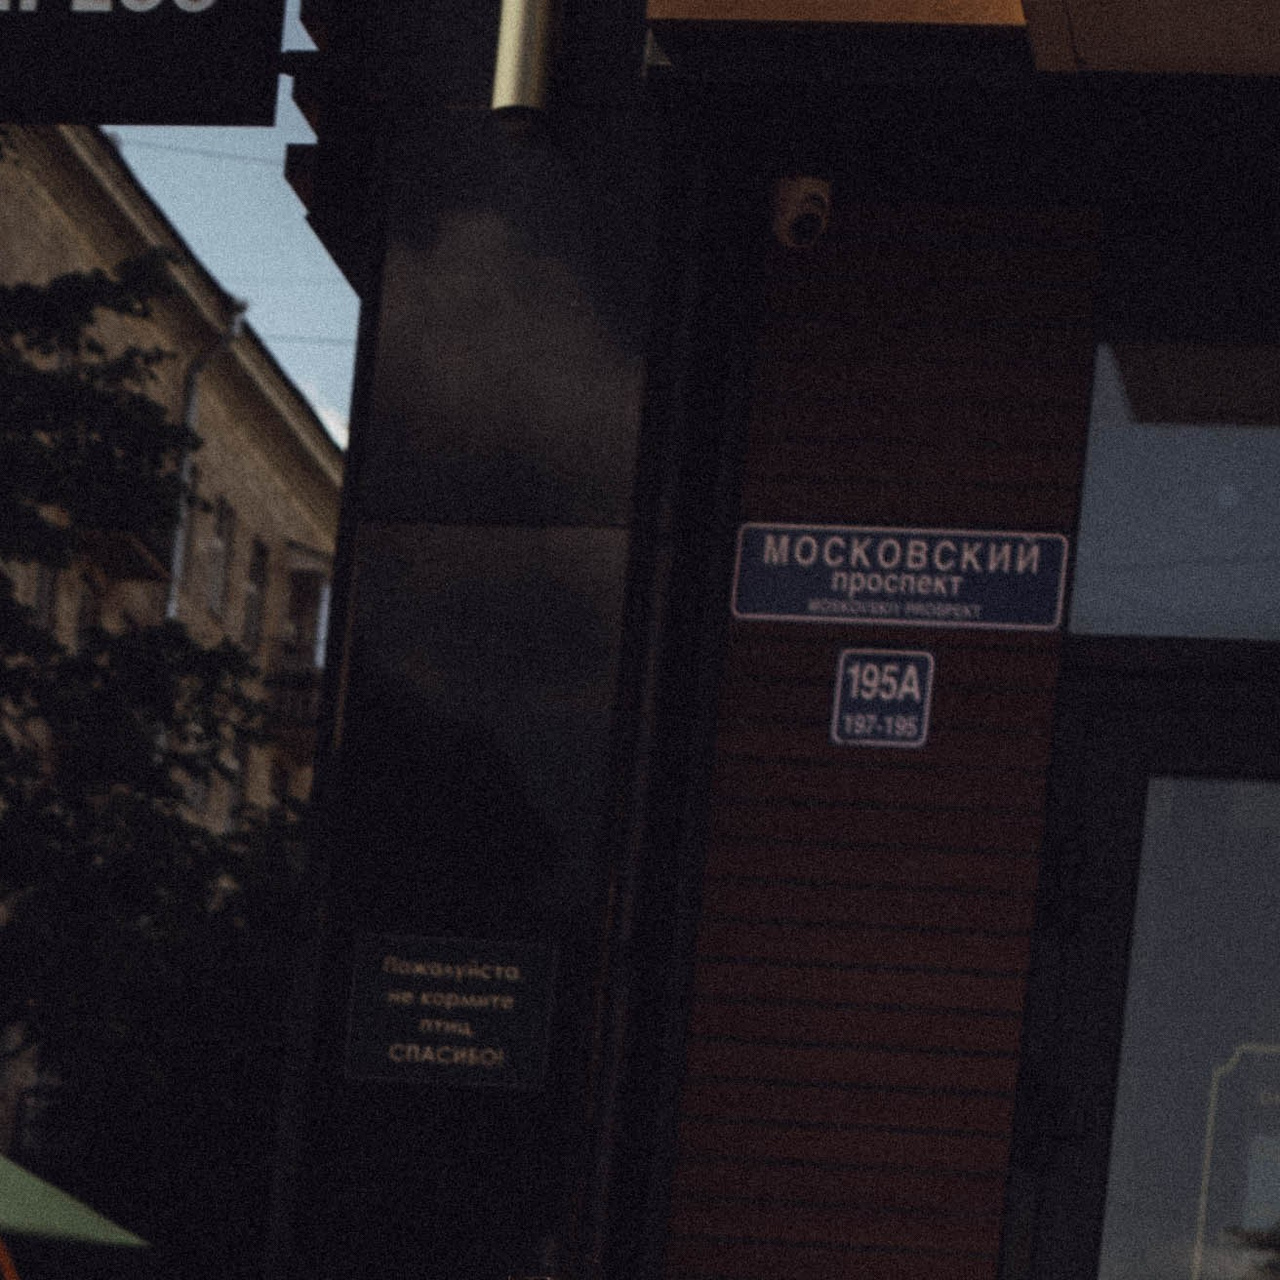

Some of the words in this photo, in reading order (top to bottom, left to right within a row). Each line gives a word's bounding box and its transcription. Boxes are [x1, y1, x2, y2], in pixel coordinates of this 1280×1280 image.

[763, 534, 1040, 574] МОСКОВСКИЙ
[830, 570, 963, 597] проспект
[846, 662, 921, 703] 195А
